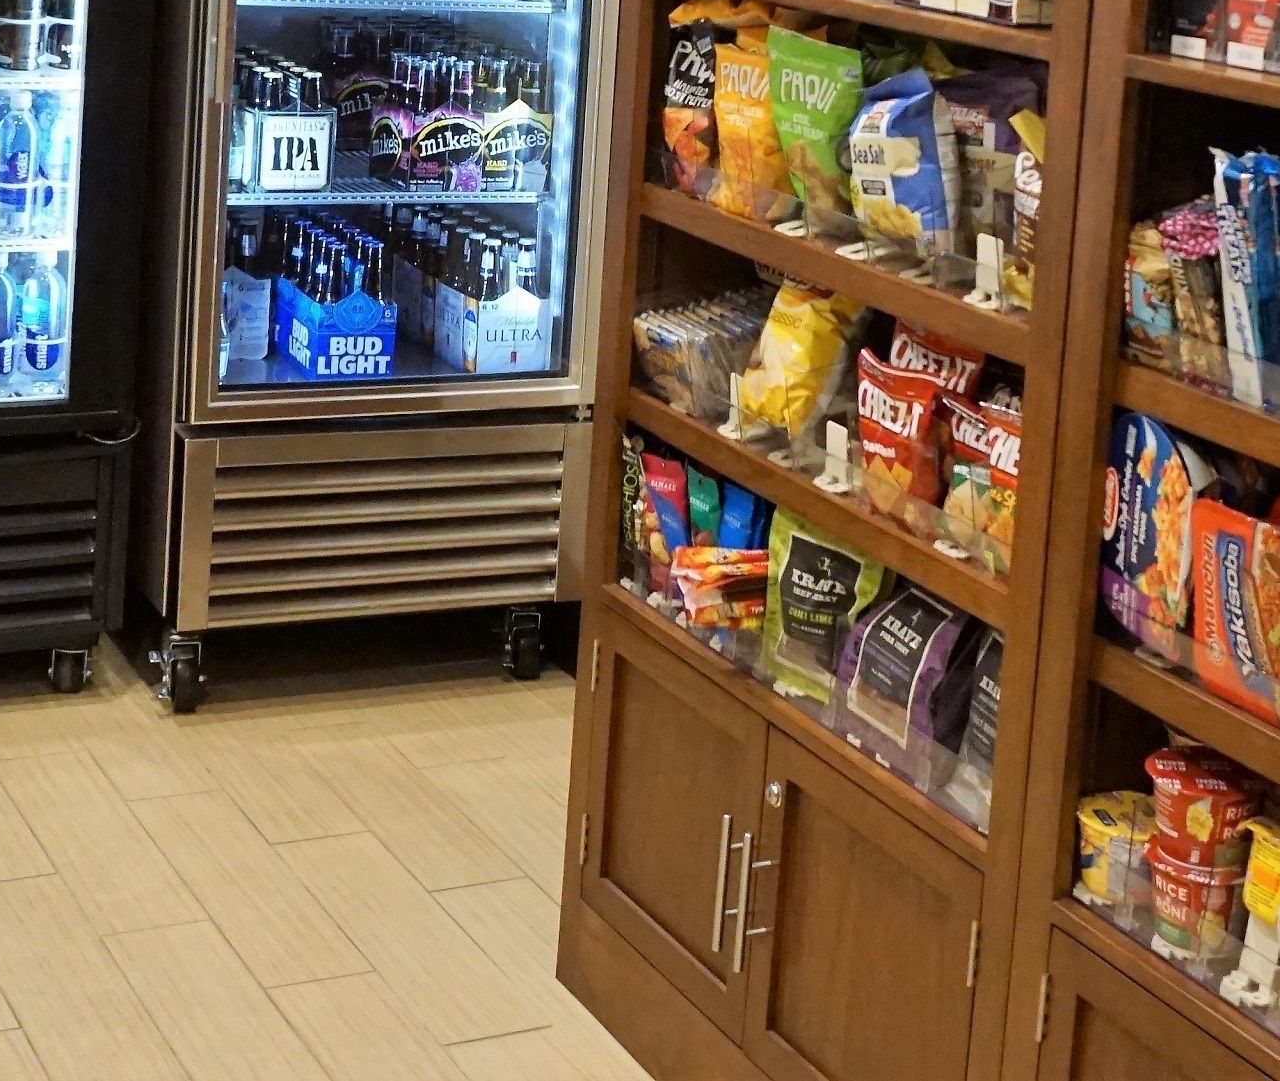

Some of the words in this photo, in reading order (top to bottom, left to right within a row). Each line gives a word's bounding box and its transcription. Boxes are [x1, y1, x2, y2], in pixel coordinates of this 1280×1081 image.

[271, 136, 320, 171] IPA
[372, 132, 399, 157] mike's
[419, 129, 482, 157] mike's
[489, 130, 547, 156] mike's
[853, 143, 868, 165] Sea
[869, 143, 886, 166] Salt
[329, 336, 383, 356] BUD
[486, 328, 543, 343] ULTRA
[316, 355, 391, 375] LIGHT
[882, 614, 924, 650] KRAVE
[1155, 874, 1189, 902] RICE
